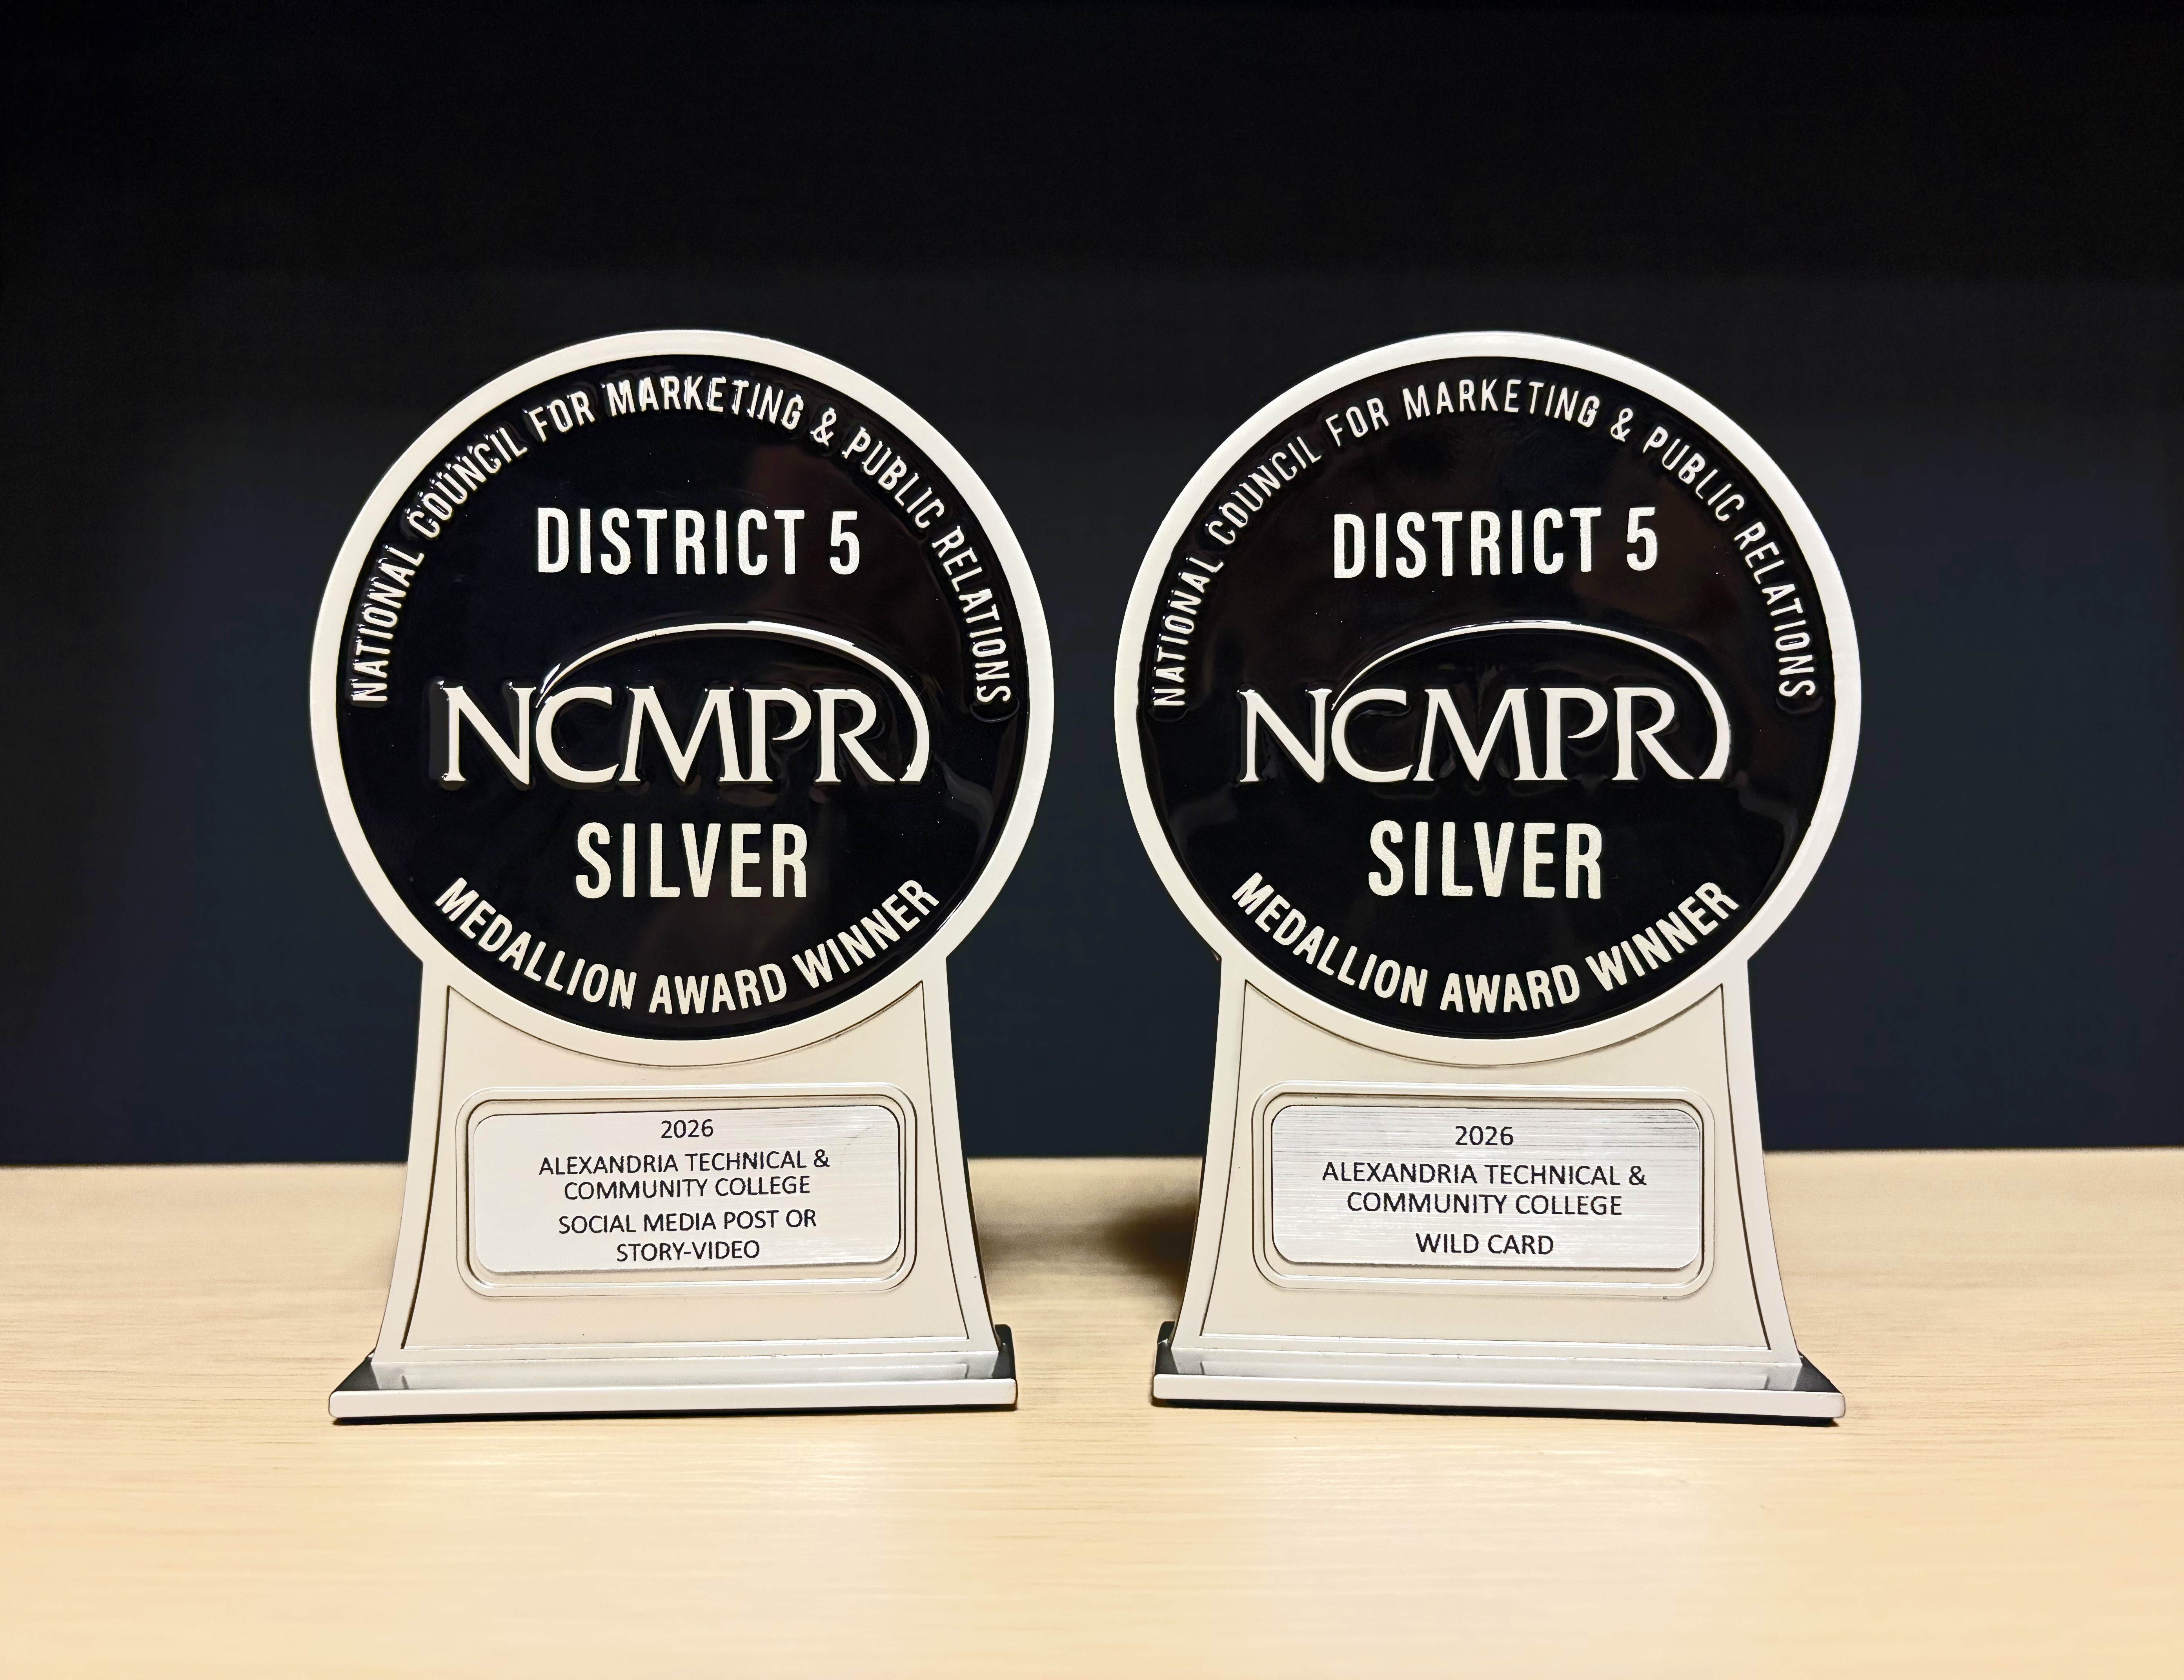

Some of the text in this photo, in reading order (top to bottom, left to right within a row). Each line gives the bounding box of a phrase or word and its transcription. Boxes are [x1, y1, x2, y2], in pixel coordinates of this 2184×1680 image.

[351, 375, 1012, 705] NATIONAL COUNCIL FOR MARKETING & PUBLIC RELATIONS
[537, 508, 861, 576] DISTRICT 5
[1154, 379, 1817, 707] NATIONAL COUNCIL FOR MARKETING & PUBLIC RELATIONS
[1333, 507, 1658, 579] DISTRICT 5
[440, 682, 890, 785] NCMPR
[1238, 686, 1695, 783] NCMPR
[575, 822, 808, 899] SILVER
[1368, 820, 1602, 899] SILVER
[434, 877, 939, 1015] MEDALLION AWARD WINNER
[1230, 872, 1740, 1013] MEDALLION AWARD WINNER
[539, 1149, 830, 1176] ALEXANDRIA TECHNICAL &
[660, 1119, 714, 1139] 2026
[1454, 1125, 1514, 1146] 2026
[564, 1176, 810, 1200] COMMUNITY COLLEGE
[1322, 1162, 1646, 1186] ALEXANDRIA TECHNICAL &
[1346, 1192, 1623, 1216] COMMUNITY COLLEGE
[559, 1209, 817, 1234] SOCIAL MEDIA POST OR
[616, 1240, 760, 1262] STORY-VIDEO
[1416, 1233, 1554, 1255] WILD CARD
